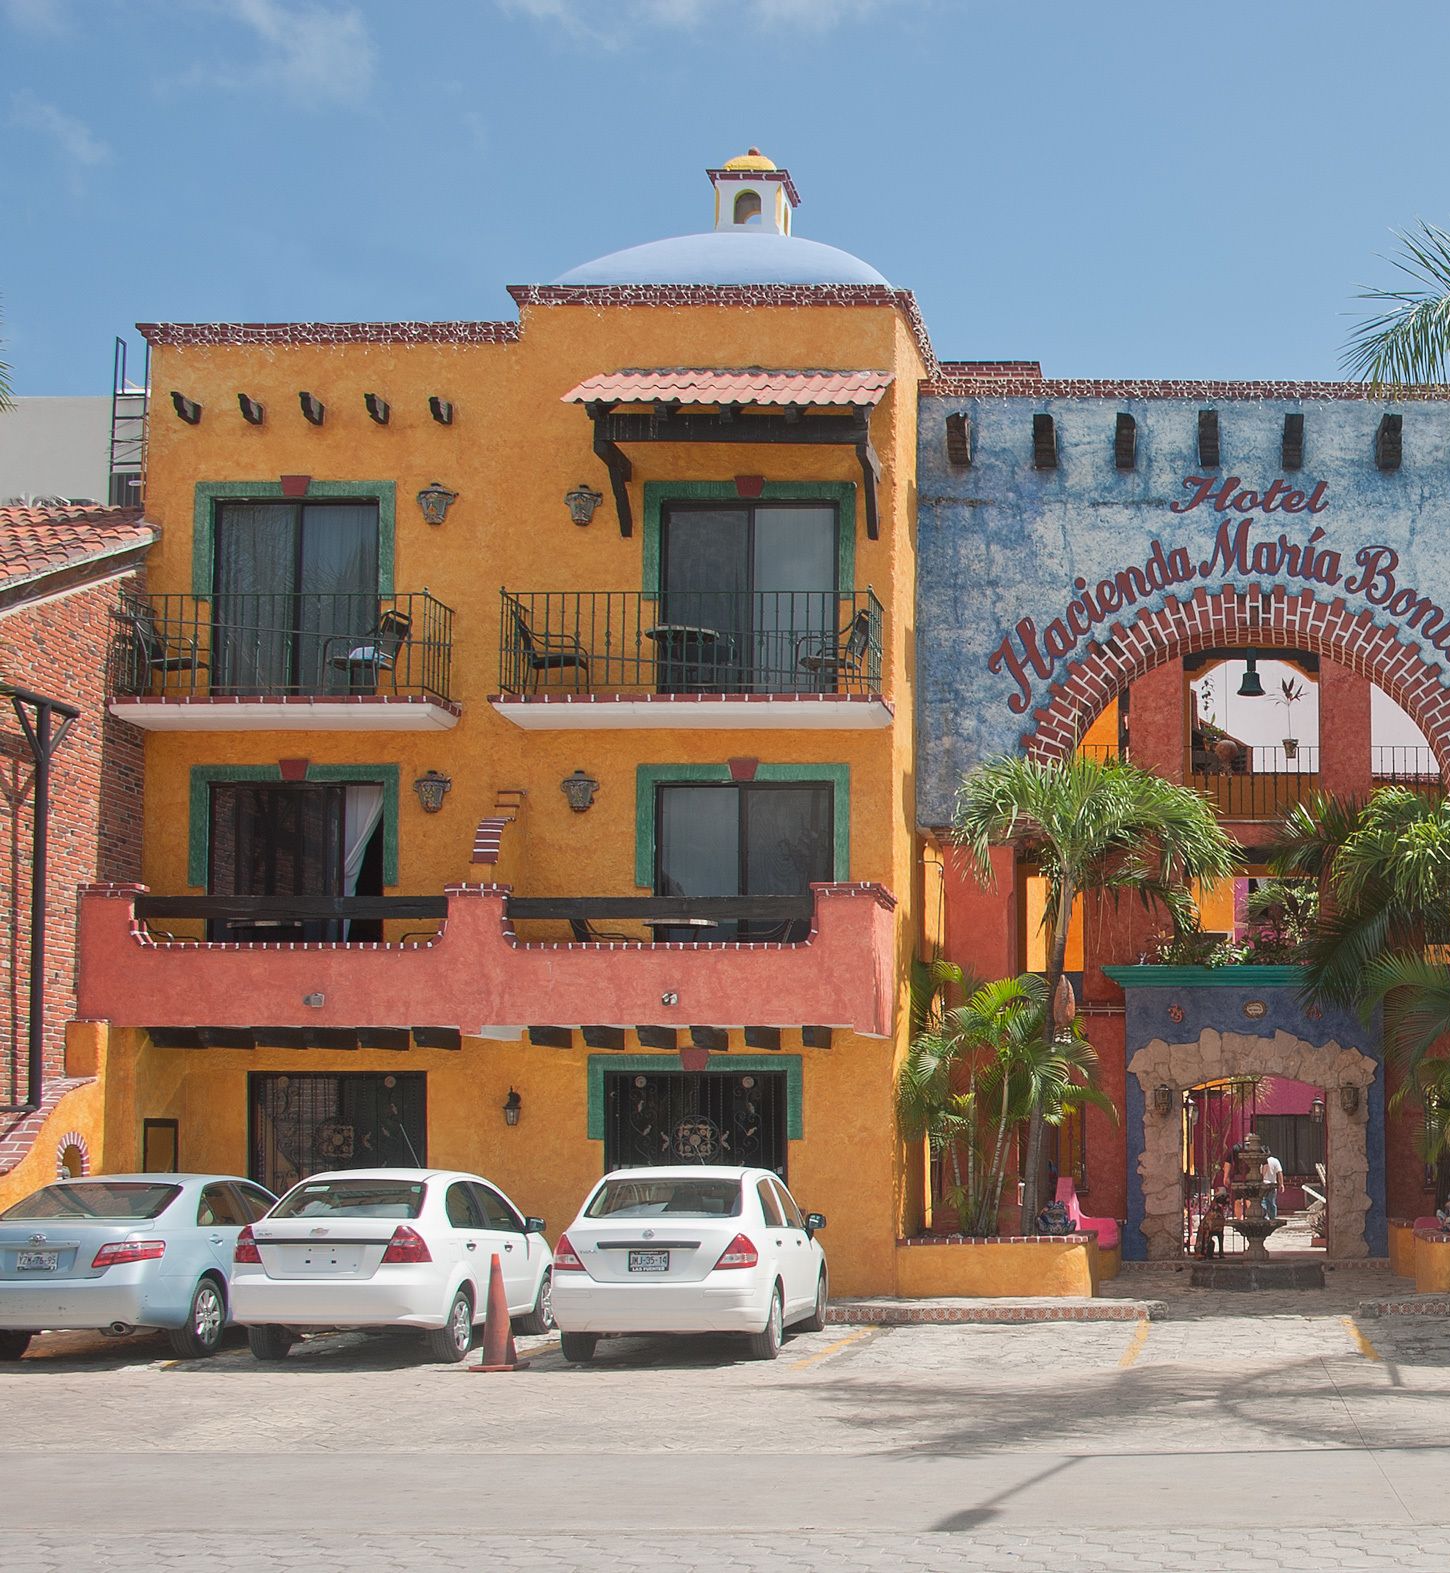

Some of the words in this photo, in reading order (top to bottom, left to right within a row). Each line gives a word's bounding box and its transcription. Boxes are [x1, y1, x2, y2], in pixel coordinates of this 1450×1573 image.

[1170, 476, 1329, 513] Hotel
[988, 539, 1197, 714] Hacienda
[1200, 518, 1343, 586] María
